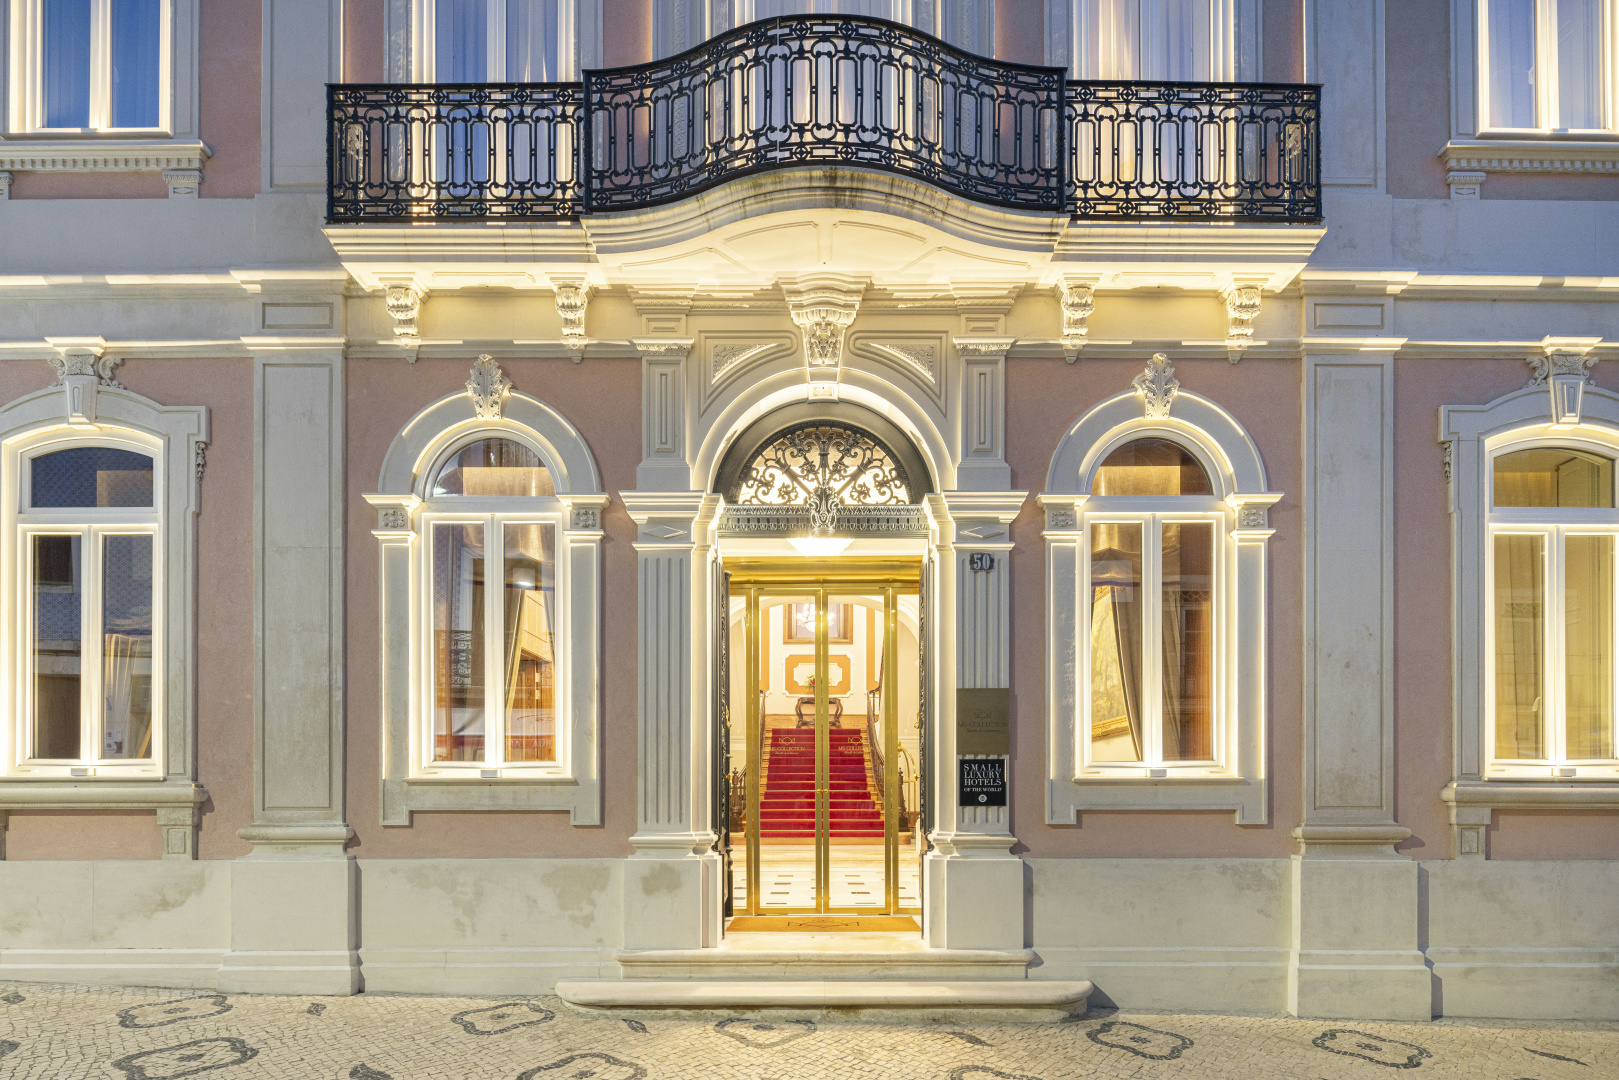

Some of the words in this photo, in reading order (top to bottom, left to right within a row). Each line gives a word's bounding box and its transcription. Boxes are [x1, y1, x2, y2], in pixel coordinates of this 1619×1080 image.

[973, 553, 990, 570] 50
[963, 763, 1002, 771] SMALL
[964, 771, 1001, 779] LUXURY
[964, 778, 1002, 786] HOTELS
